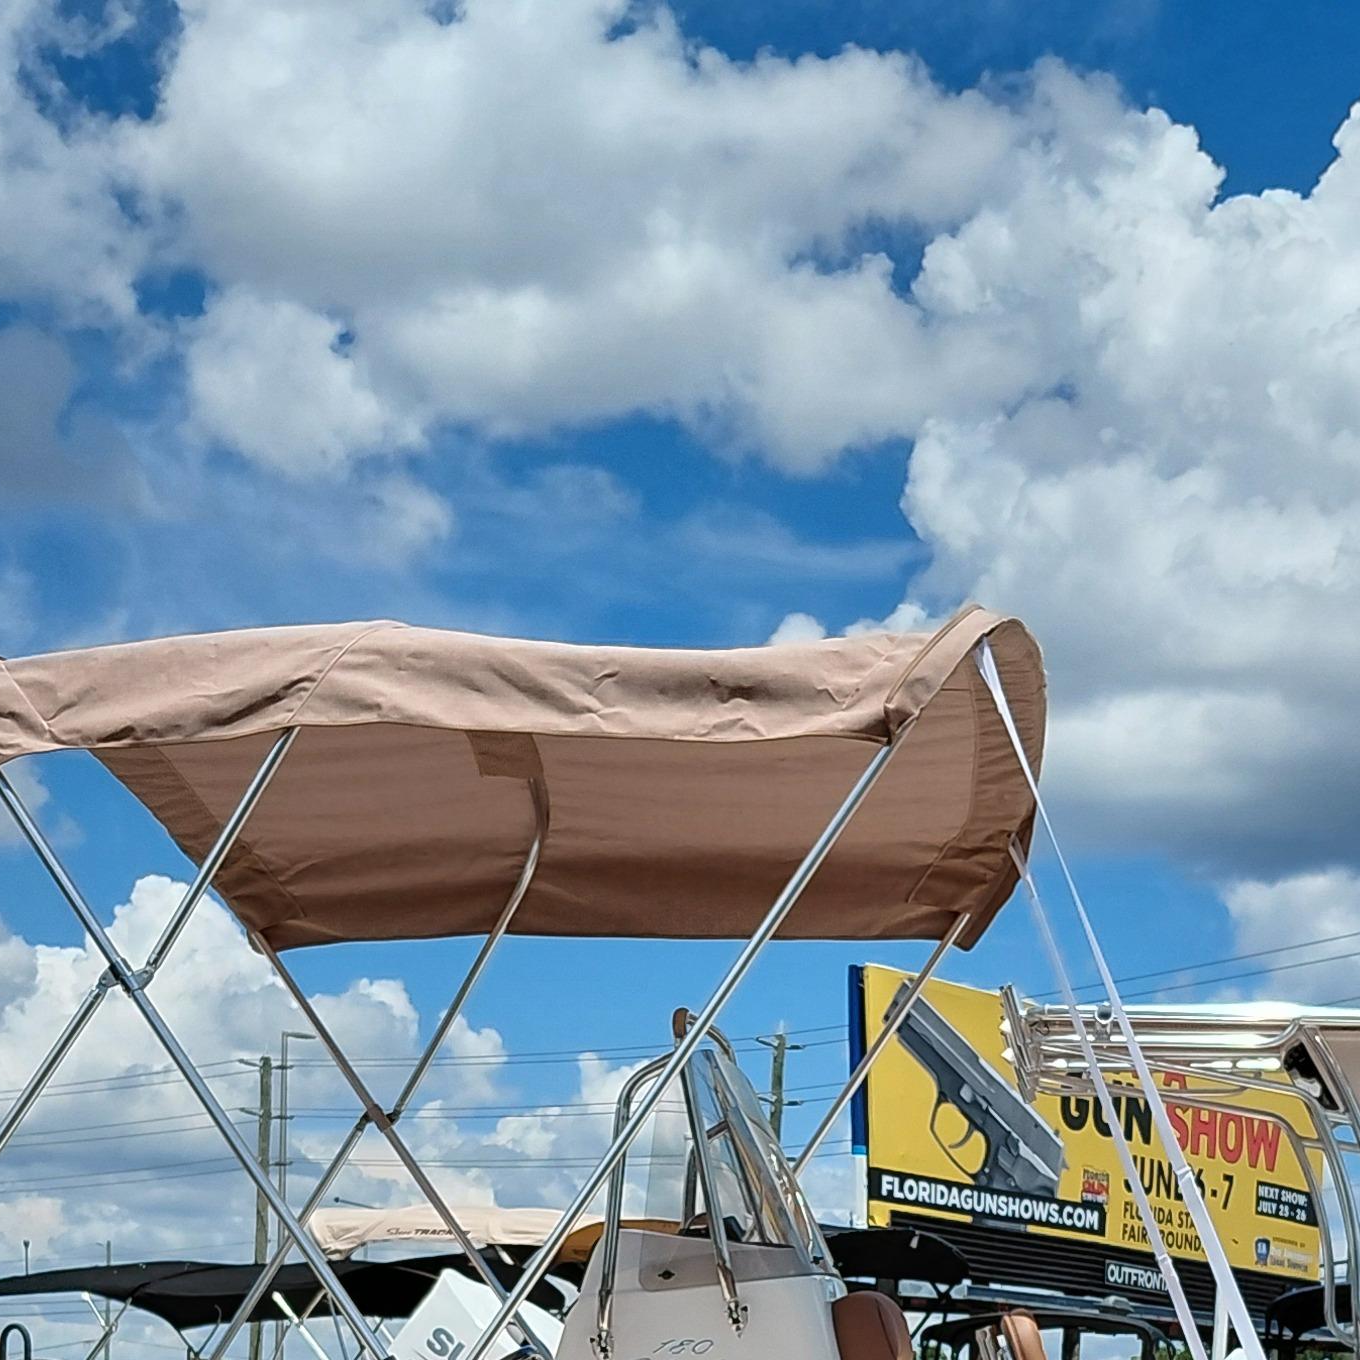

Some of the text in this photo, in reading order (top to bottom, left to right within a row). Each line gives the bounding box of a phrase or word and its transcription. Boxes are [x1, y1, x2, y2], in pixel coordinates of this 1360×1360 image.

[1164, 1103, 1282, 1173] SHOW
[880, 1173, 1100, 1231] FLORIDAGUNSHOWS.COM
[1257, 1184, 1280, 1201] NEXT
[1122, 1201, 1174, 1227] FLOIDA
[1257, 1199, 1278, 1215] JULY
[414, 1228, 471, 1236] TRACK
[1121, 1222, 1207, 1255] FAIRROUND
